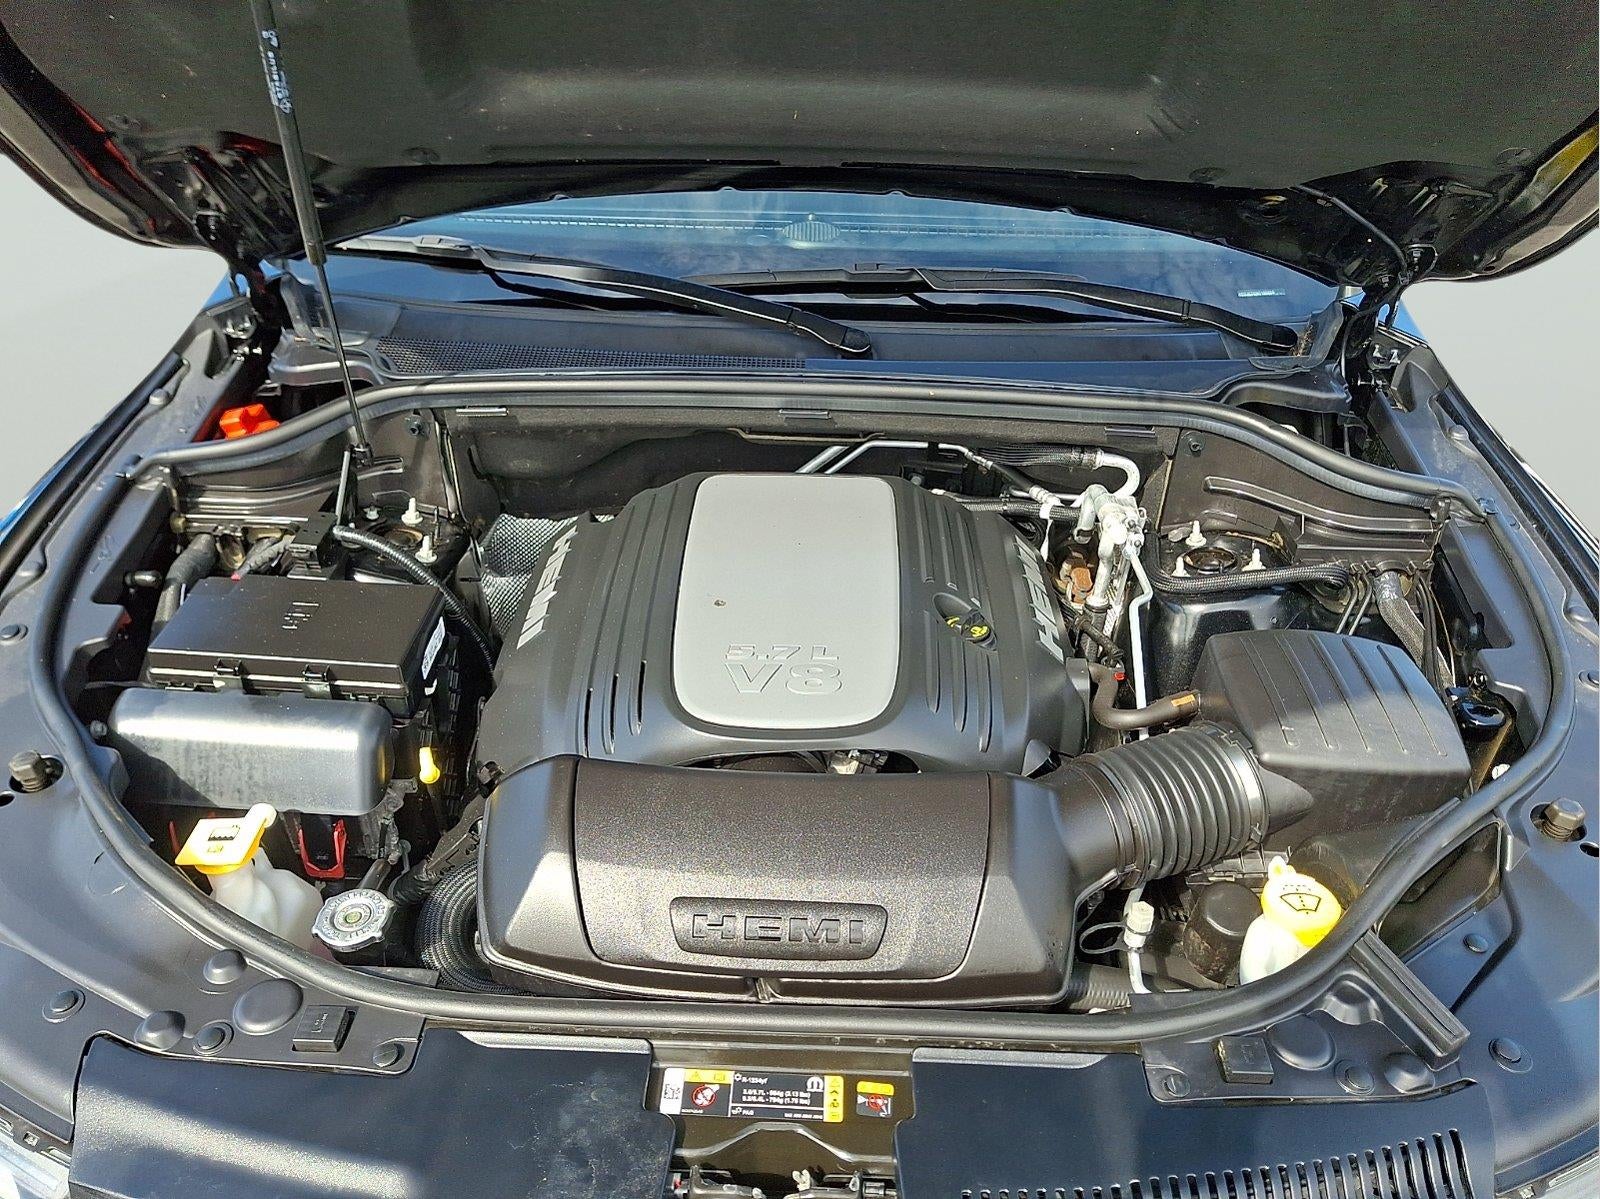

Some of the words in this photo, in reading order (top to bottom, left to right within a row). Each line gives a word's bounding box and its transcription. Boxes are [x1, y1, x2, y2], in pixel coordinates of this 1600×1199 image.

[516, 525, 578, 650] HEMI
[1014, 535, 1064, 664] HEMI
[724, 662, 843, 694] V8
[692, 913, 864, 945] HEMI
